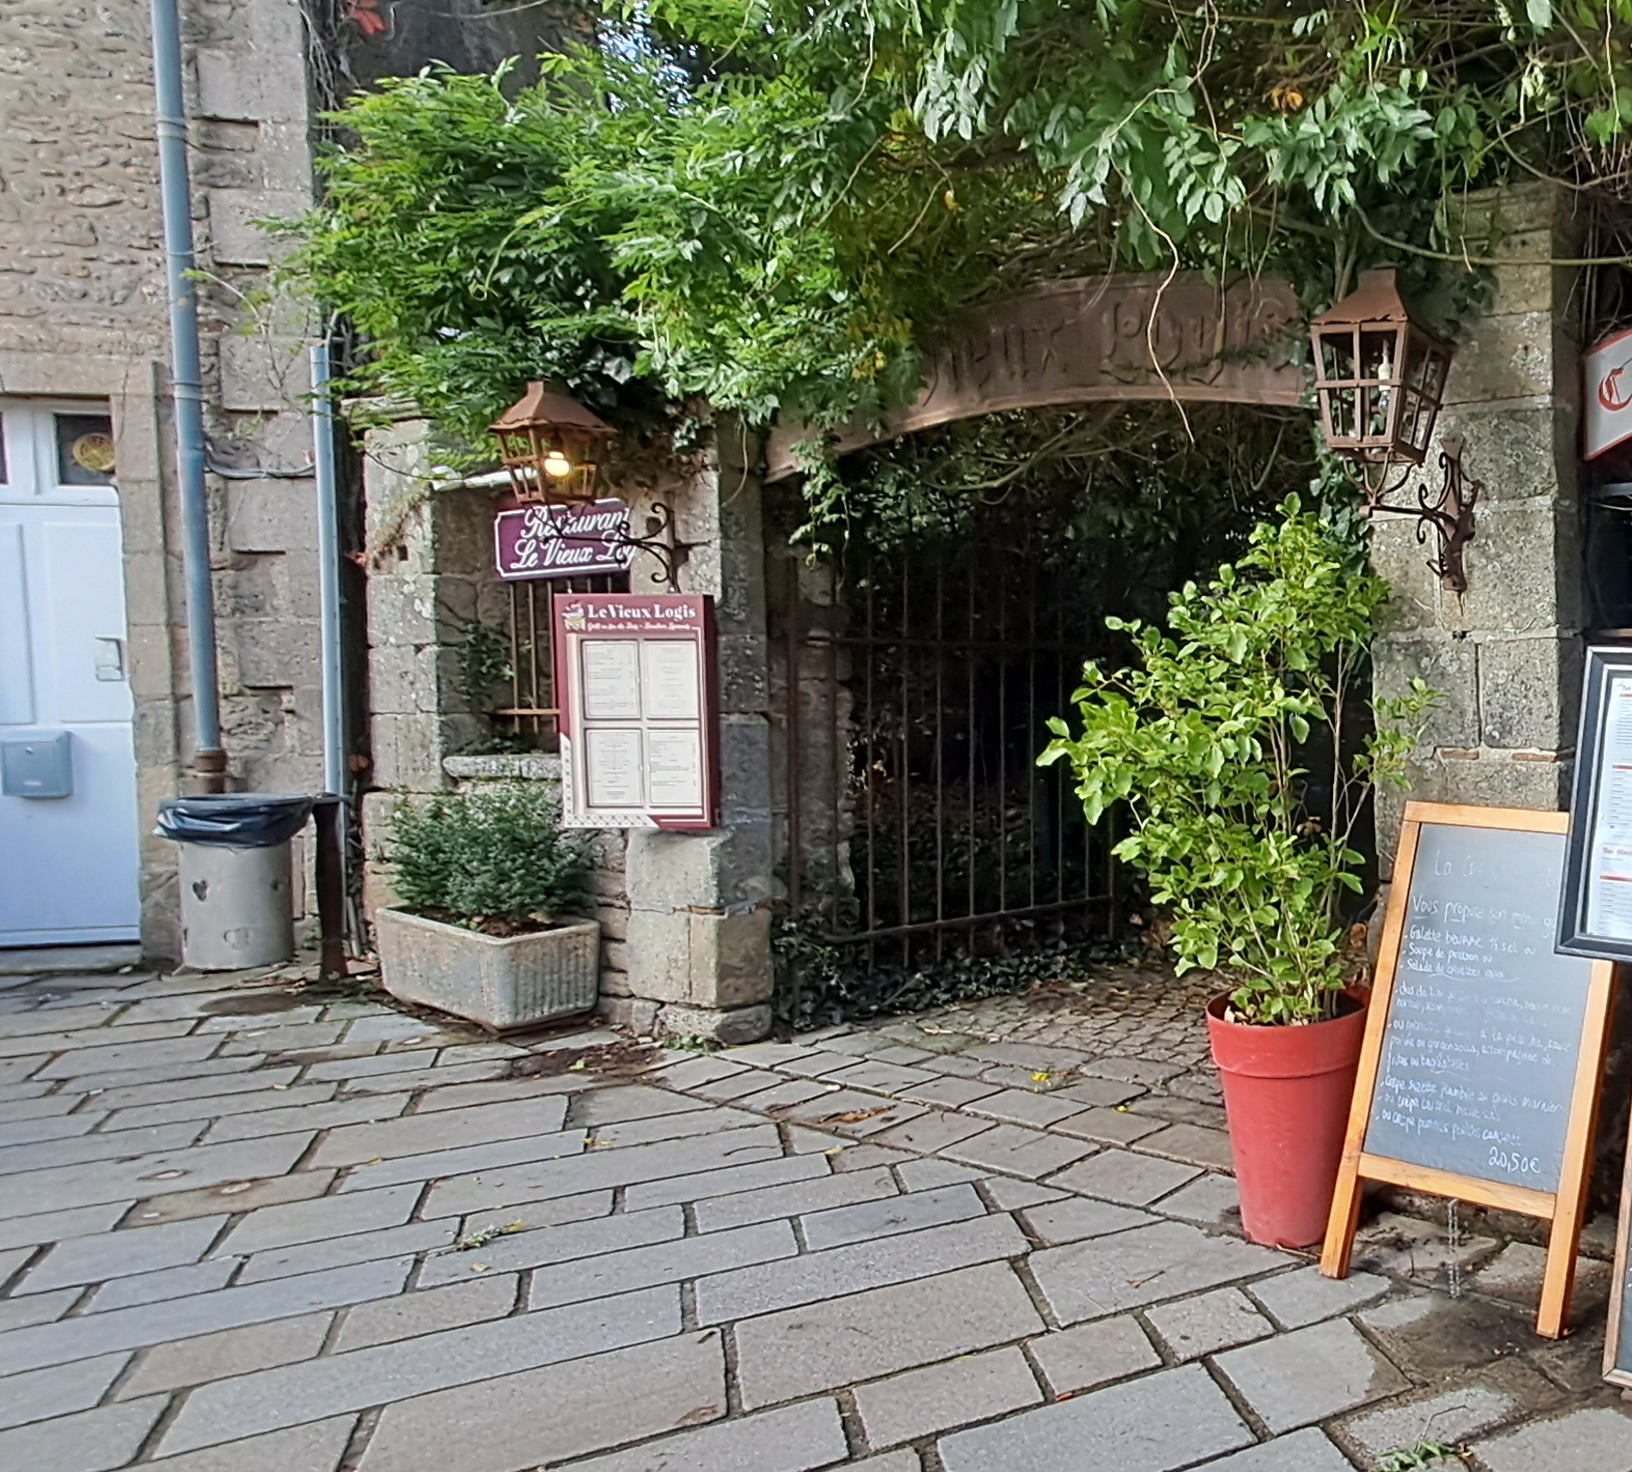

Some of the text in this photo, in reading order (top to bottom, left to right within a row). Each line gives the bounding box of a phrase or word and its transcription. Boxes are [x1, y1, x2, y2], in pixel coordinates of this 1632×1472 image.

[510, 539, 538, 569] Le
[540, 538, 594, 567] Vieux
[587, 604, 696, 622] Le Vieux Logis
[1435, 850, 1452, 876] La
[1413, 892, 1439, 915] Vous
[1410, 924, 1442, 943] Galette
[1446, 930, 1483, 948] beurre
[1501, 942, 1518, 954] sel
[1409, 942, 1433, 961] Soupe
[1436, 946, 1445, 959] de
[1448, 950, 1479, 963] poisson
[1407, 959, 1433, 973] Salade
[1434, 962, 1445, 974] de
[1487, 1145, 1543, 1174] 20,50€
